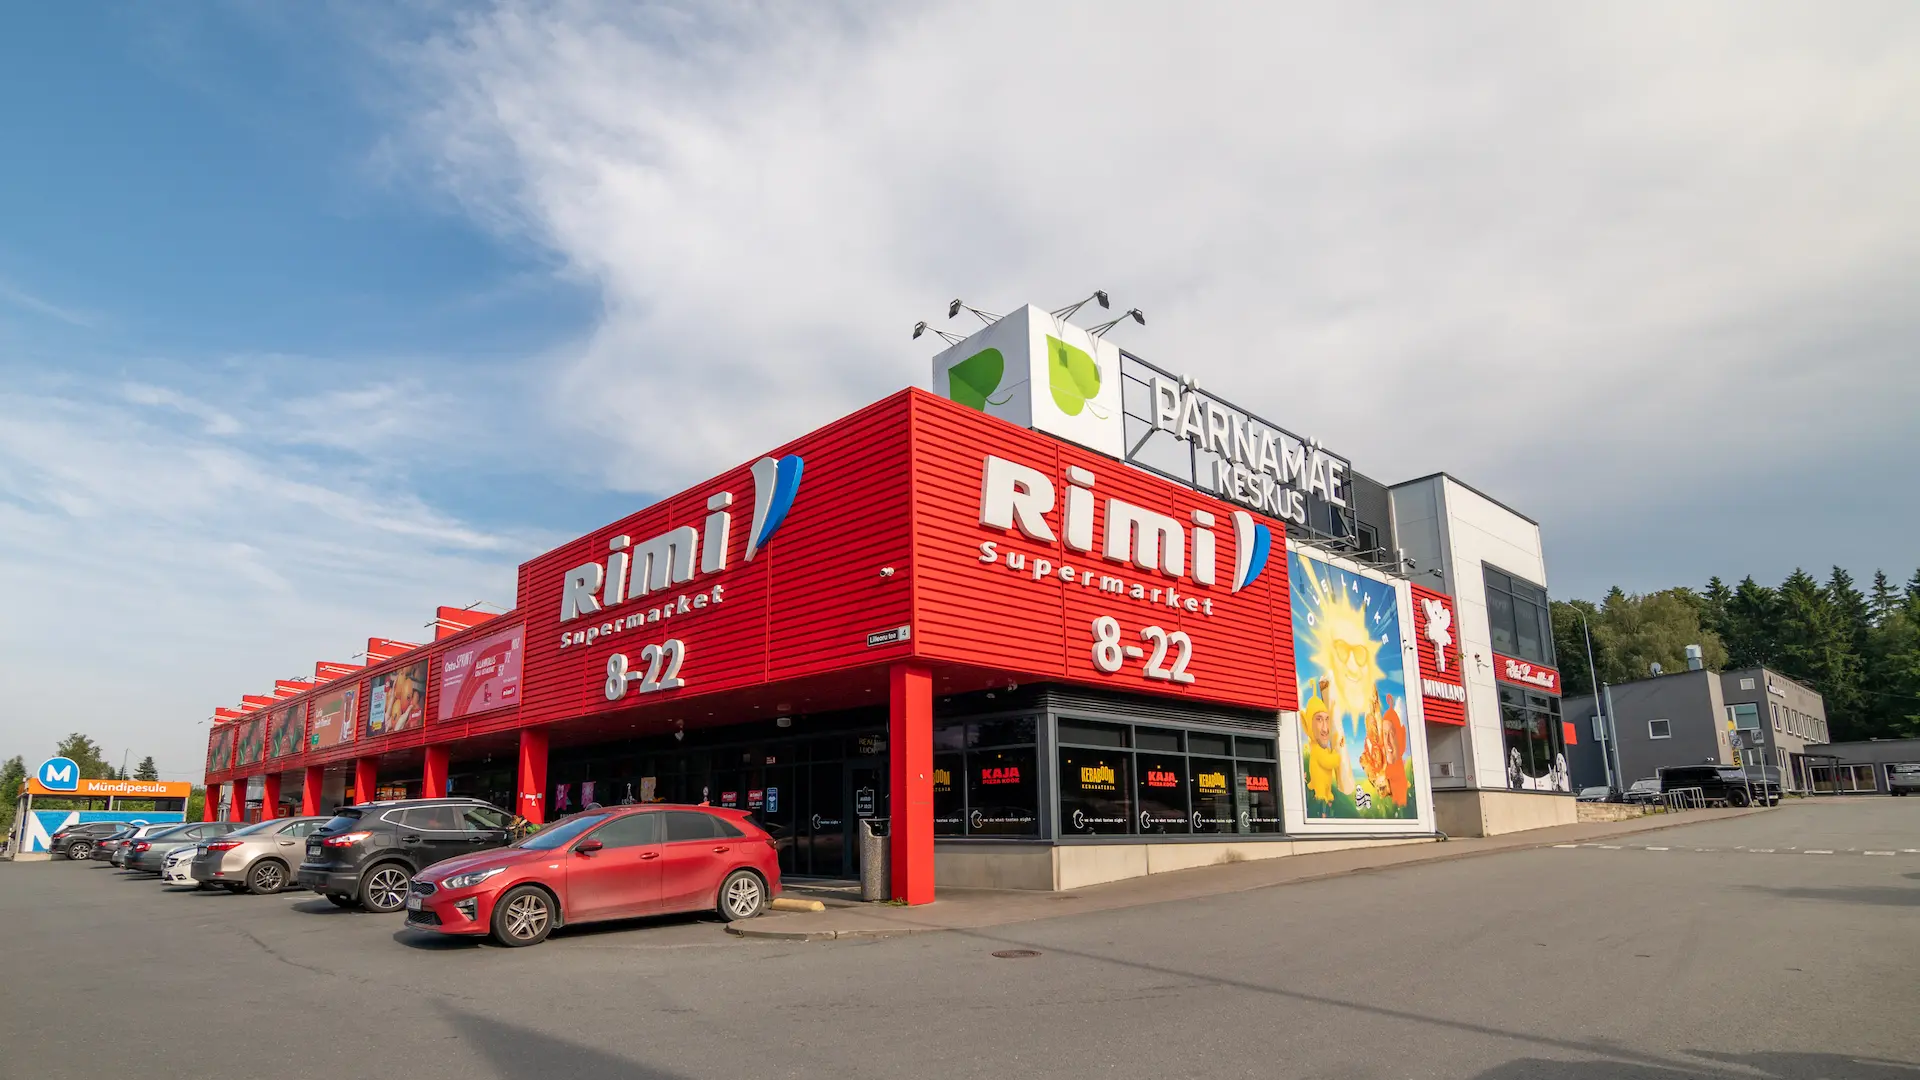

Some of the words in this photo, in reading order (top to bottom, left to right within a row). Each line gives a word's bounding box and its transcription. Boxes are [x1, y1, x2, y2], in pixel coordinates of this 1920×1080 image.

[1150, 373, 1347, 508] PÄRNAMÄE
[979, 454, 1217, 586] Rimi
[1212, 459, 1306, 525] KESKUS
[560, 491, 733, 622] Rimi
[978, 541, 1214, 617] Supermarket
[560, 584, 725, 648] Supermarket
[605, 638, 685, 701] 8-22
[1091, 615, 1196, 684] 8-22
[1420, 678, 1465, 703] MINILAND
[46, 764, 71, 782] M
[88, 782, 167, 794] Mündipesula
[982, 767, 1020, 779] KAJA
[1081, 766, 1115, 784] KEBABOOM
[1148, 771, 1176, 782] KAJA
[1246, 776, 1269, 787] KAJA
